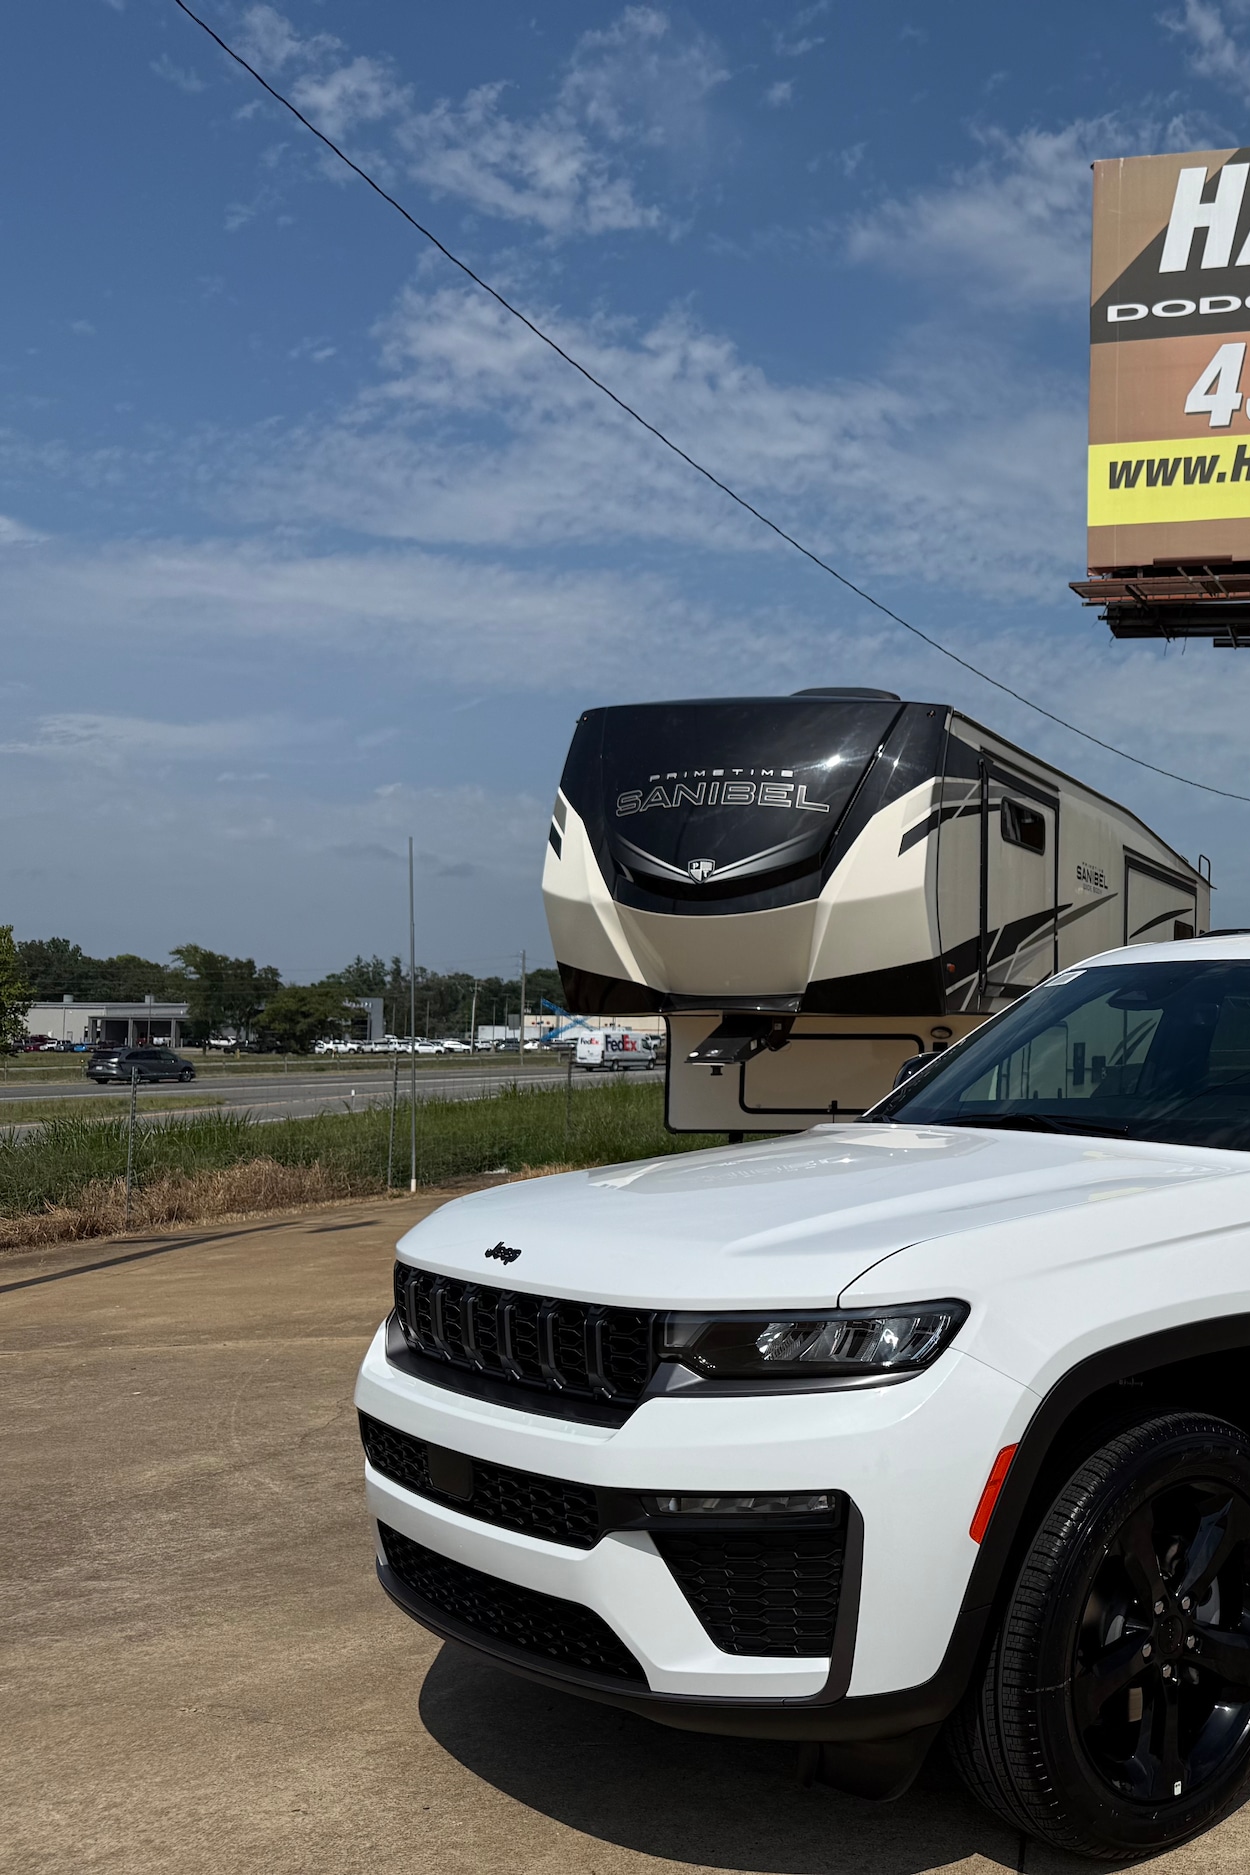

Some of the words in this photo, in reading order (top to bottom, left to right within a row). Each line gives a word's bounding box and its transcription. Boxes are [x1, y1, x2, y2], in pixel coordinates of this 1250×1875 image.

[616, 781, 830, 817] SANIBEL
[1076, 865, 1108, 890] SANIBEL
[580, 1037, 600, 1045] FedEx
[605, 1033, 638, 1052] FedEx
[485, 1241, 522, 1265] Jeep
